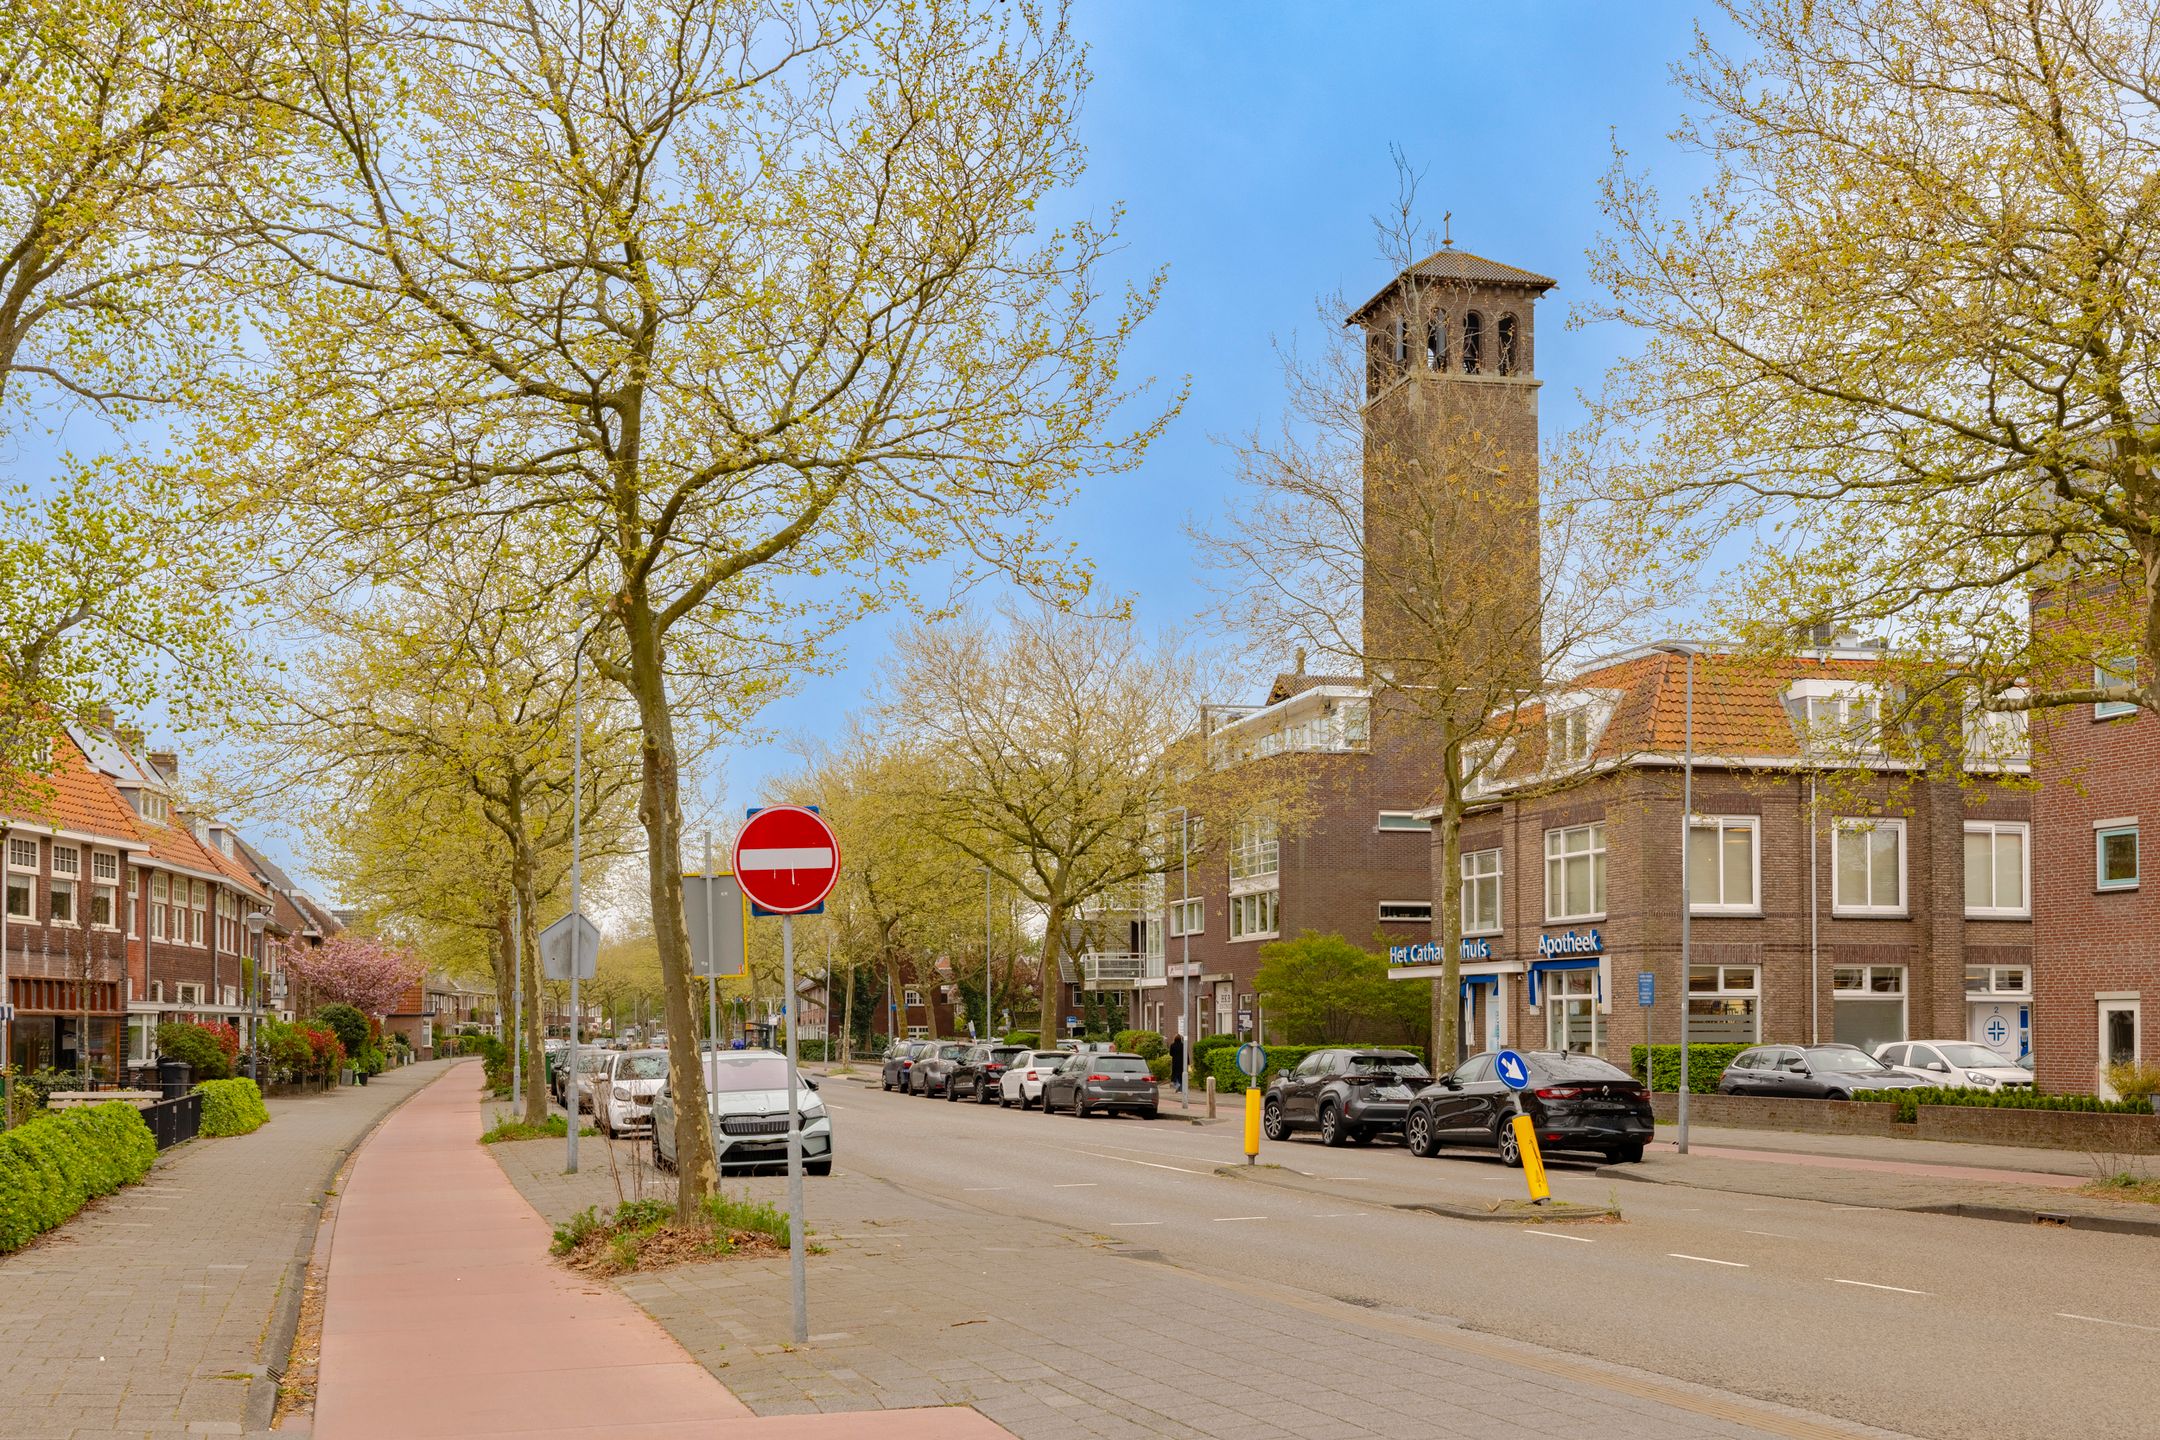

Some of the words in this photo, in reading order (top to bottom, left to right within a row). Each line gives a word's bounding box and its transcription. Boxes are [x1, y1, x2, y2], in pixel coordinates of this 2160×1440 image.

[1538, 929, 1600, 958] Apotheek
[1390, 945, 1409, 963] Het
[1993, 1006, 2000, 1014] 2
